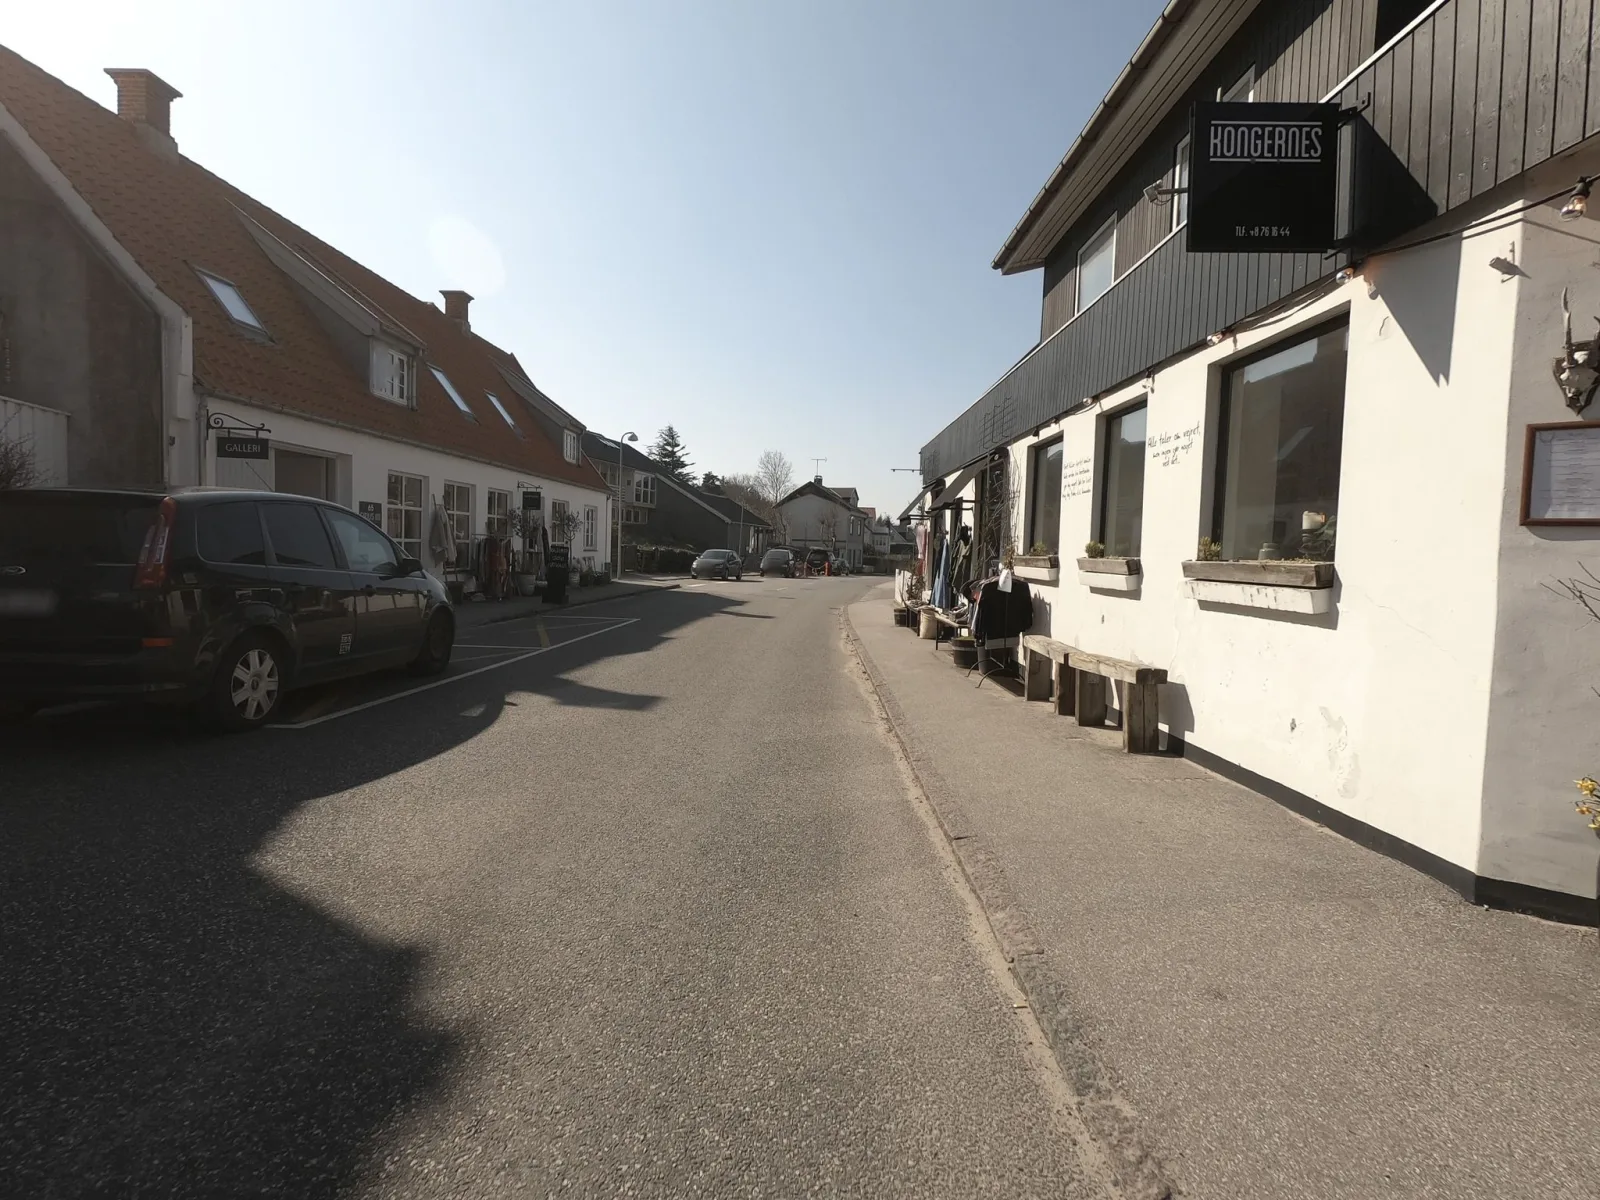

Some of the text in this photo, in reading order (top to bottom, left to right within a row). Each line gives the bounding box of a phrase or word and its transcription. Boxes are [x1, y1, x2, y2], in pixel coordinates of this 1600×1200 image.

[1209, 125, 1323, 158] KONGERNES
[1279, 226, 1290, 237] 44
[225, 443, 261, 453] GALLERI
